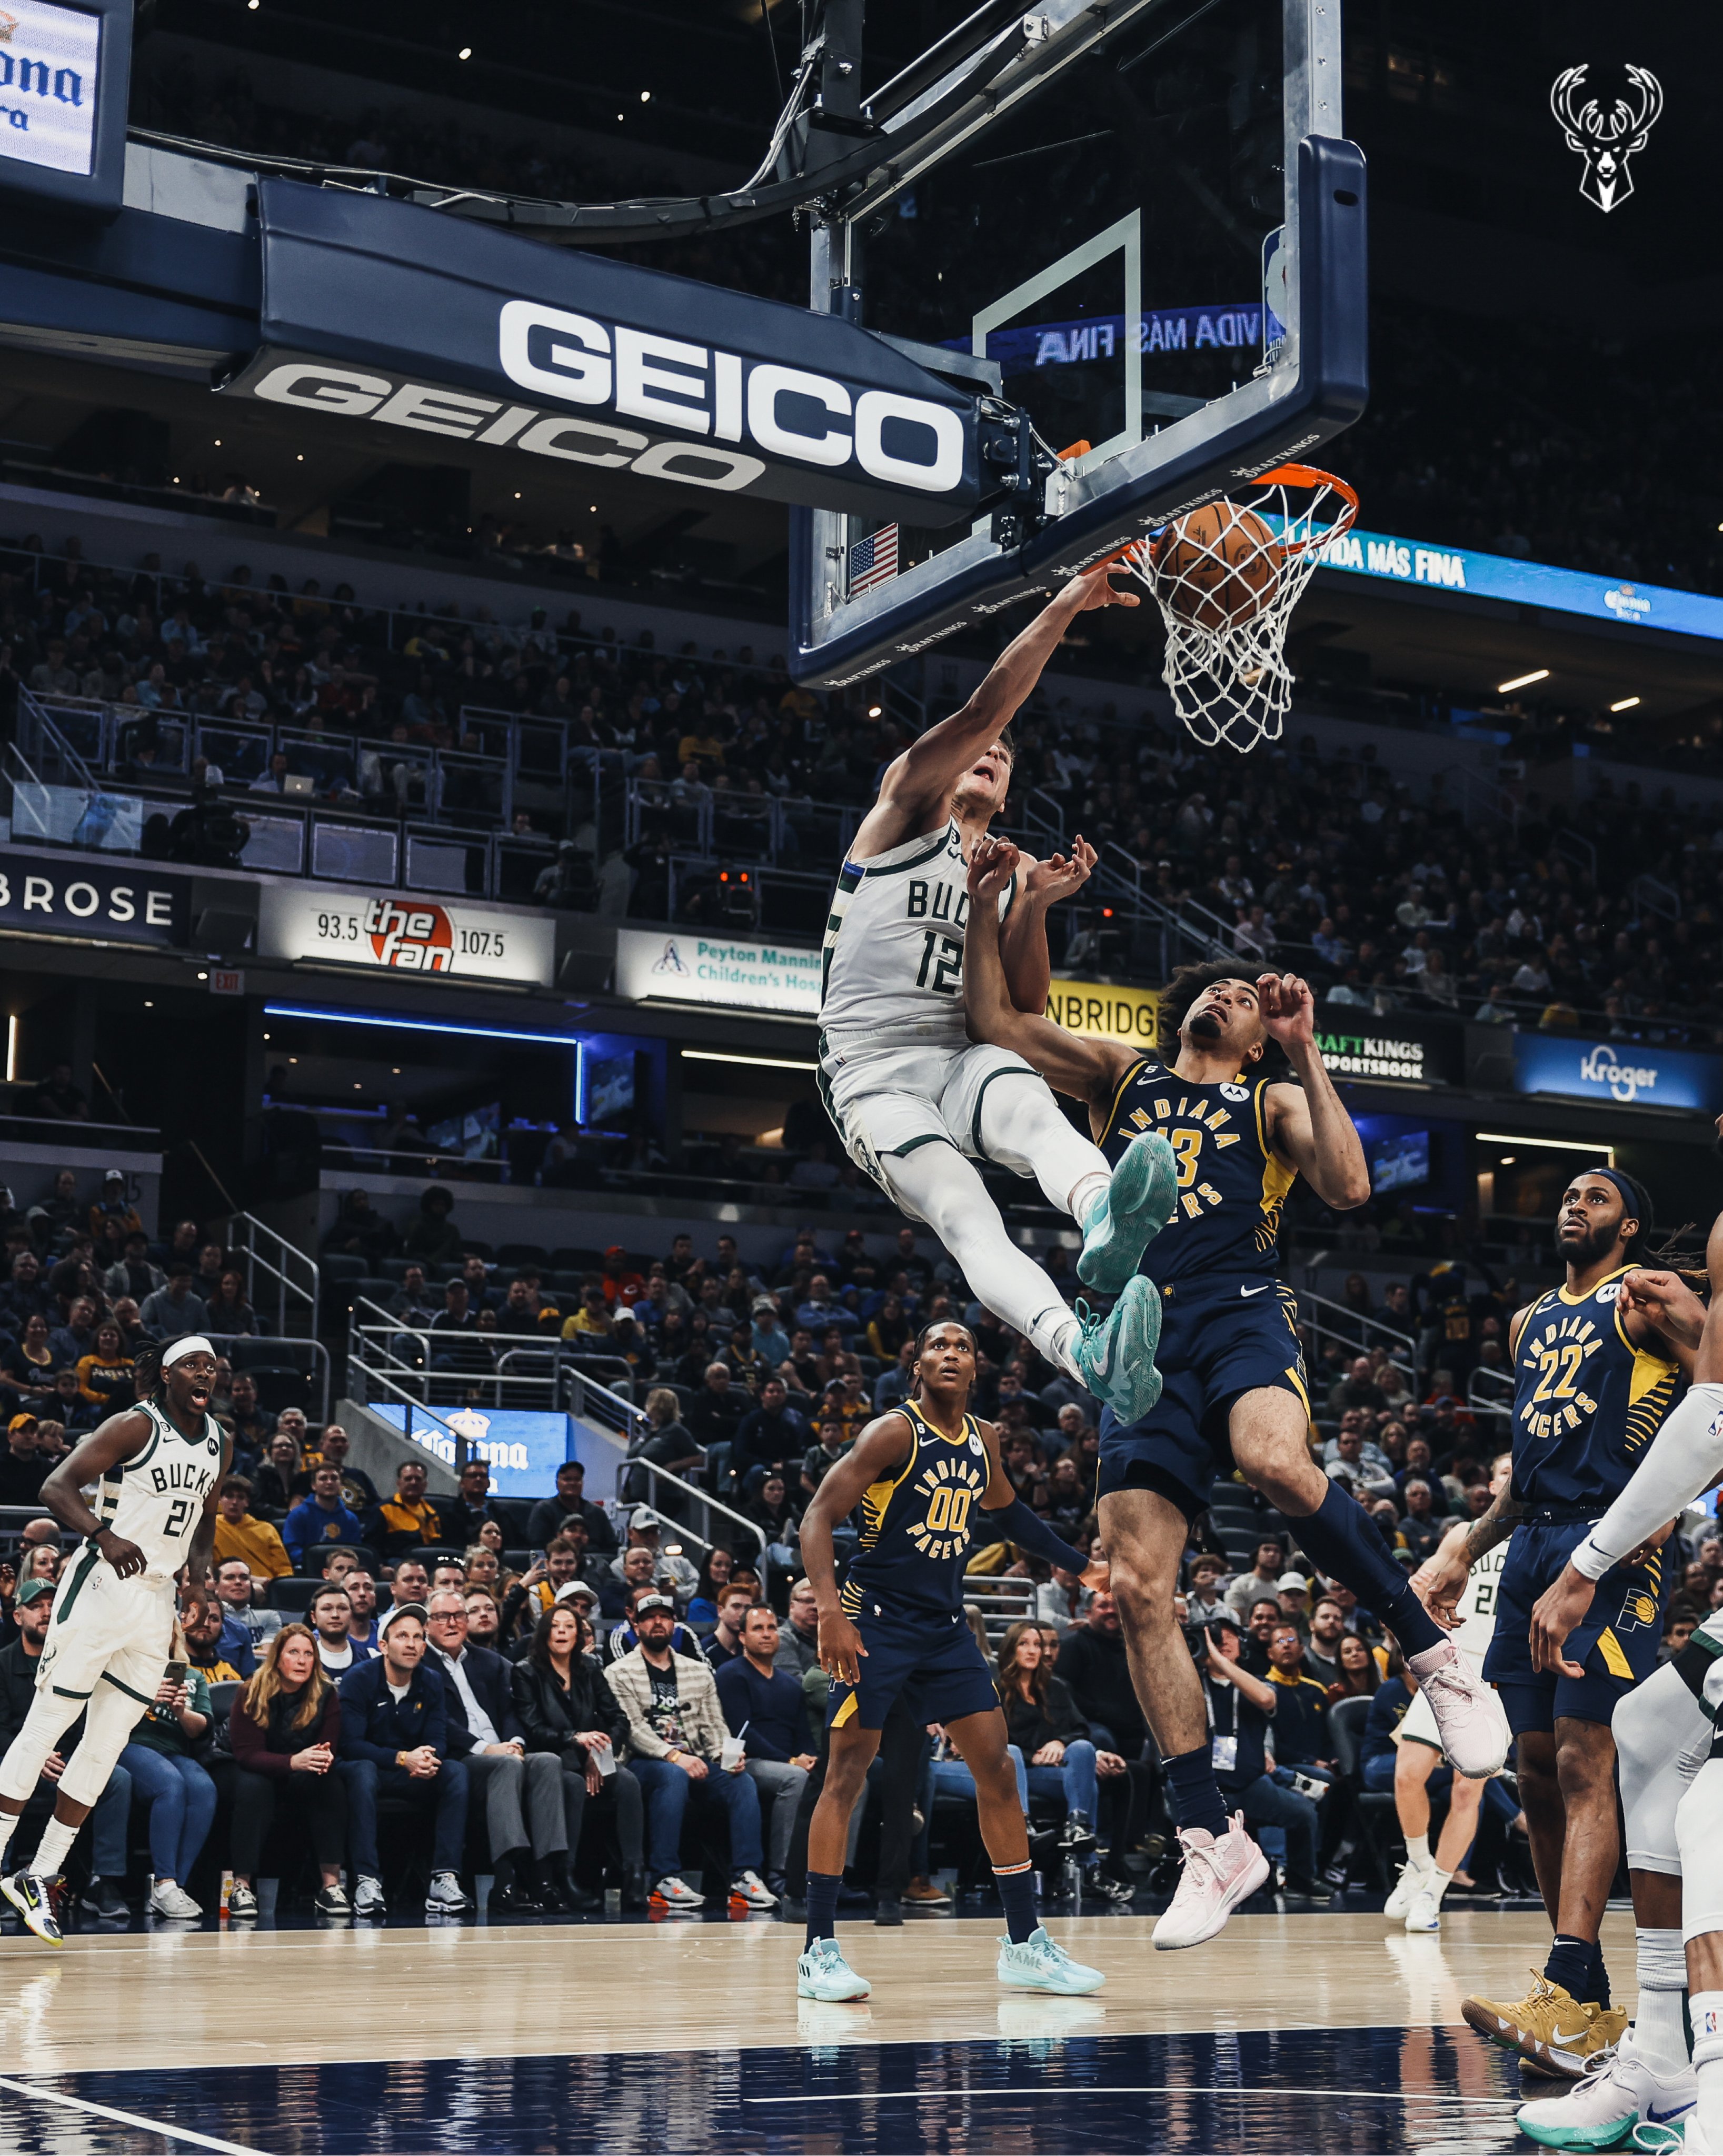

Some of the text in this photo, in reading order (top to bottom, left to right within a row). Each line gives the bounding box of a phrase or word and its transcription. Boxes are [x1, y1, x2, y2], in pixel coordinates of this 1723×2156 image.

[500, 300, 964, 492] GEICO
[254, 363, 766, 491] GEICO
[1243, 434, 1320, 478] DRAFTKINGS
[1150, 488, 1222, 527] DRAFTKINGS
[1063, 536, 1131, 577] DRAFTKINGS
[1367, 529, 1411, 578] MÁS
[1415, 548, 1466, 588] FINA
[982, 585, 1047, 613] DRAFTKINGS
[906, 621, 968, 653] DRAFTKINGS
[835, 658, 892, 687] DRAFTKINGS
[317, 913, 358, 941] 93.5
[364, 900, 435, 939] the
[380, 931, 453, 972] fan
[461, 930, 504, 957] 107.5
[697, 941, 756, 962] Peyton
[914, 929, 965, 996] 12
[216, 973, 238, 990] EXIT
[697, 964, 780, 987] Children's
[1045, 994, 1159, 1036] NBRIDG
[1322, 1054, 1423, 1079] SPORTSBOOK
[1581, 1045, 1658, 1102] Kroger
[1118, 1097, 1241, 1150] INDIANA
[1156, 1127, 1203, 1187] 3
[1522, 1315, 1604, 1370] INDIANA
[1532, 1344, 1583, 1403] 22
[1519, 1391, 1598, 1439] PACERS
[913, 1457, 984, 1501] INDIANA
[163, 1499, 195, 1538] 21
[927, 1486, 972, 1533] 00
[905, 1522, 971, 1560] PACERS
[1475, 1583, 1498, 1615] 2
